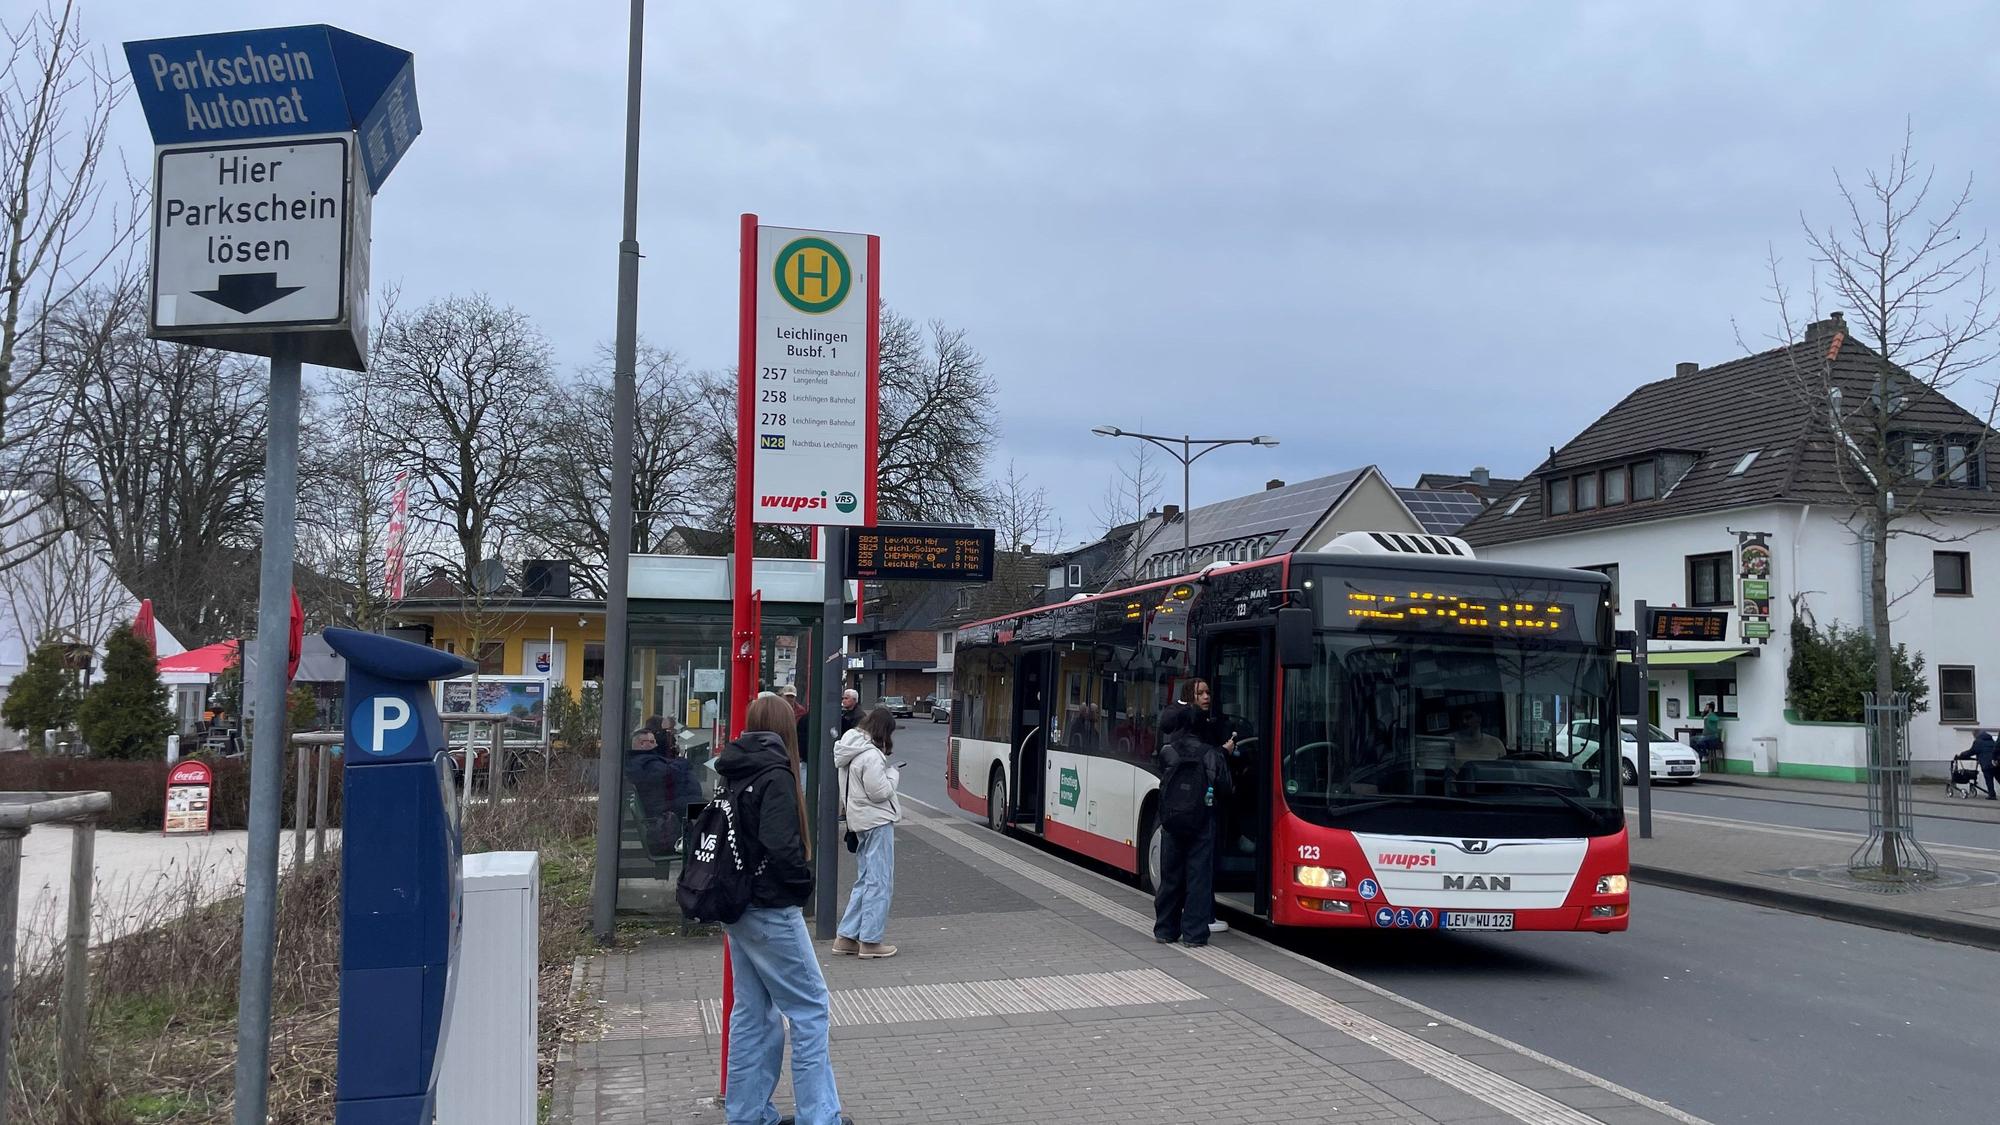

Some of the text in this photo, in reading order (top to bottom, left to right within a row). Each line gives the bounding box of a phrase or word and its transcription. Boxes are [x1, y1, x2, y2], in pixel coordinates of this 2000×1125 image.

[148, 42, 314, 92] Parkschein
[185, 87, 309, 131] Automat
[218, 156, 282, 185] Hier
[166, 191, 336, 228] Parkschein
[207, 235, 290, 264] lösen
[797, 254, 828, 297] H
[777, 327, 848, 344] Leichlingen
[787, 345, 837, 358] Busbf. 1
[762, 368, 787, 380] 257
[793, 368, 828, 376] Leichlingen
[830, 369, 857, 378] Bahnhof
[793, 377, 828, 385] Langenfeld
[762, 390, 856, 404] 258 Leichlingen Bahnhof
[762, 413, 856, 427] 278 Leichlingen Bahnhof
[761, 436, 858, 450] N28 Nachtbus Leichlingen
[760, 490, 827, 512] wupsi
[834, 495, 852, 503] VRS
[955, 539, 979, 547] sofort
[955, 546, 961, 554] 2
[858, 551, 873, 559] 255
[884, 552, 924, 560] CHEMPARK
[964, 554, 979, 562] Min
[932, 561, 947, 569] Lev
[963, 562, 979, 570] Min
[1249, 588, 1268, 600] MAN
[371, 696, 411, 752] P
[1297, 845, 1320, 860] 123
[1378, 848, 1437, 869] wupsi
[1443, 873, 1511, 891] MAN
[1447, 914, 1513, 927] LEV WU 123
